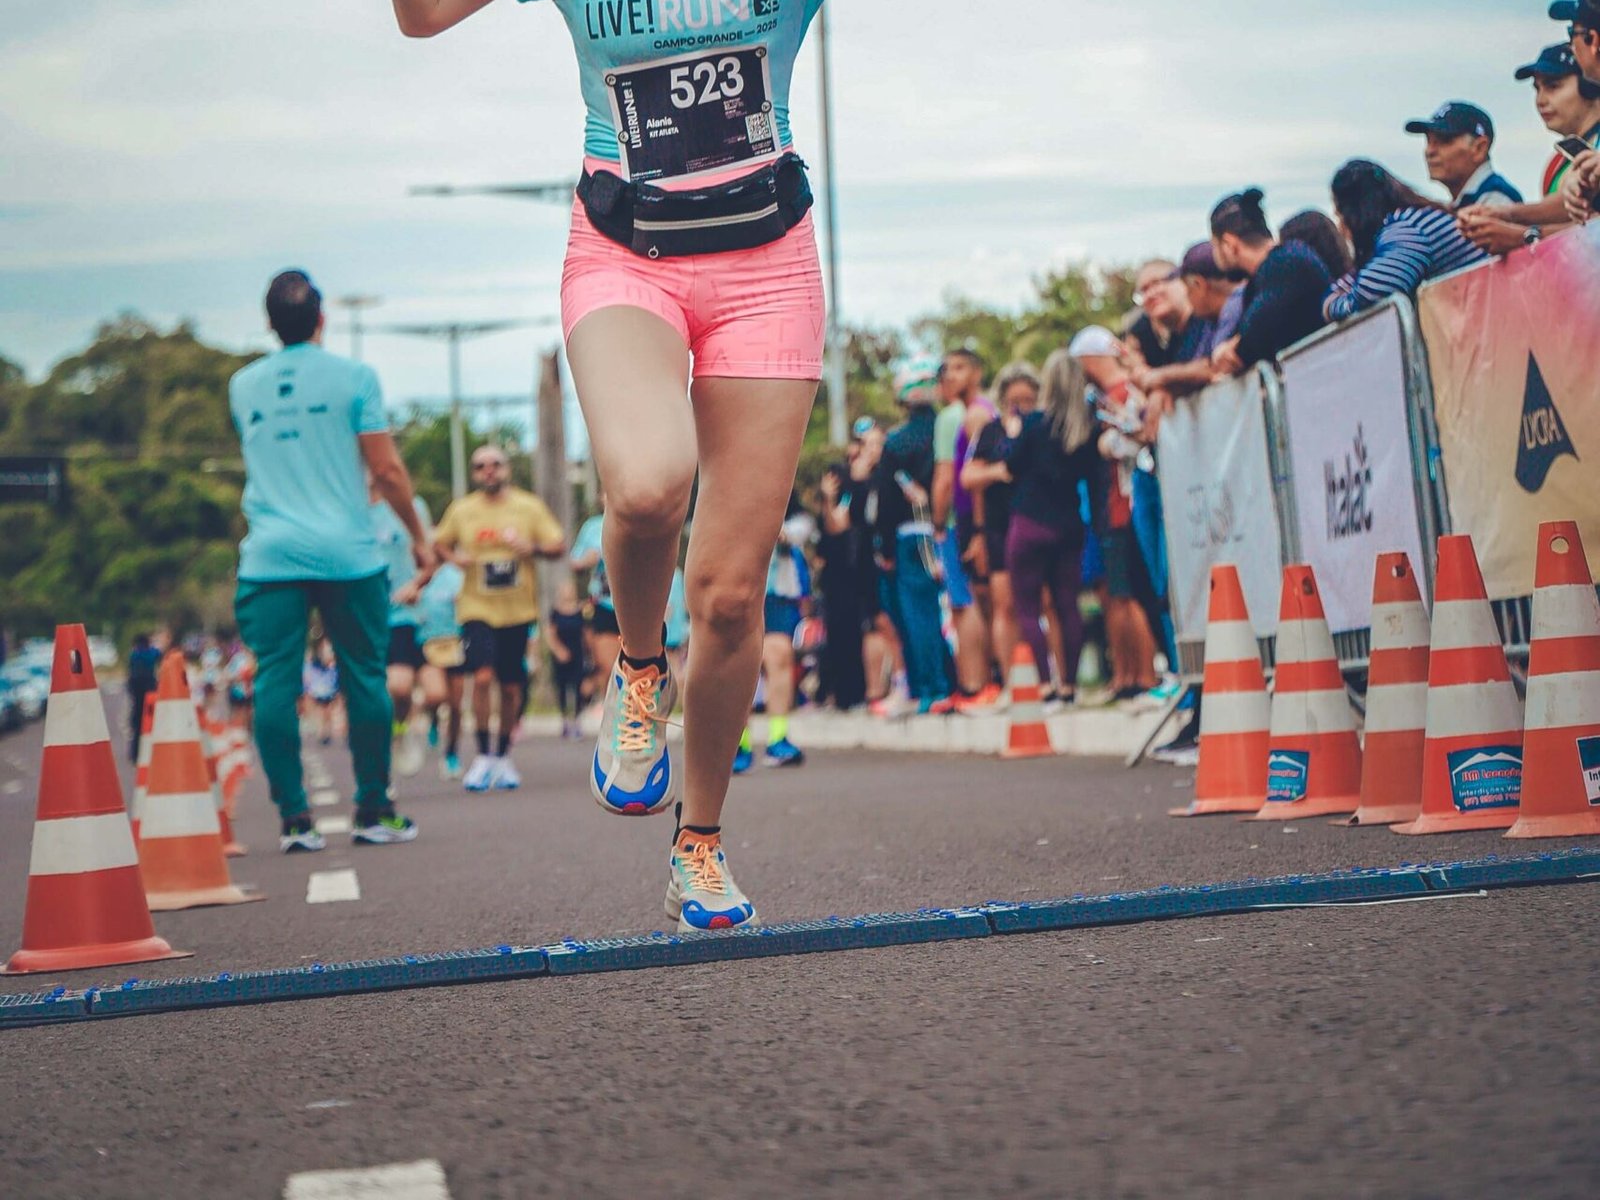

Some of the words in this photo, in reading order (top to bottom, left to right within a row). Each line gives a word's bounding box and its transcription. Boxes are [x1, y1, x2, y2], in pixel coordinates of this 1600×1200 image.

[653, 36, 695, 50] CAMPO
[697, 30, 743, 45] GRANDE
[756, 18, 778, 35] 2025
[670, 56, 745, 110] 523
[646, 116, 673, 129] Alanis
